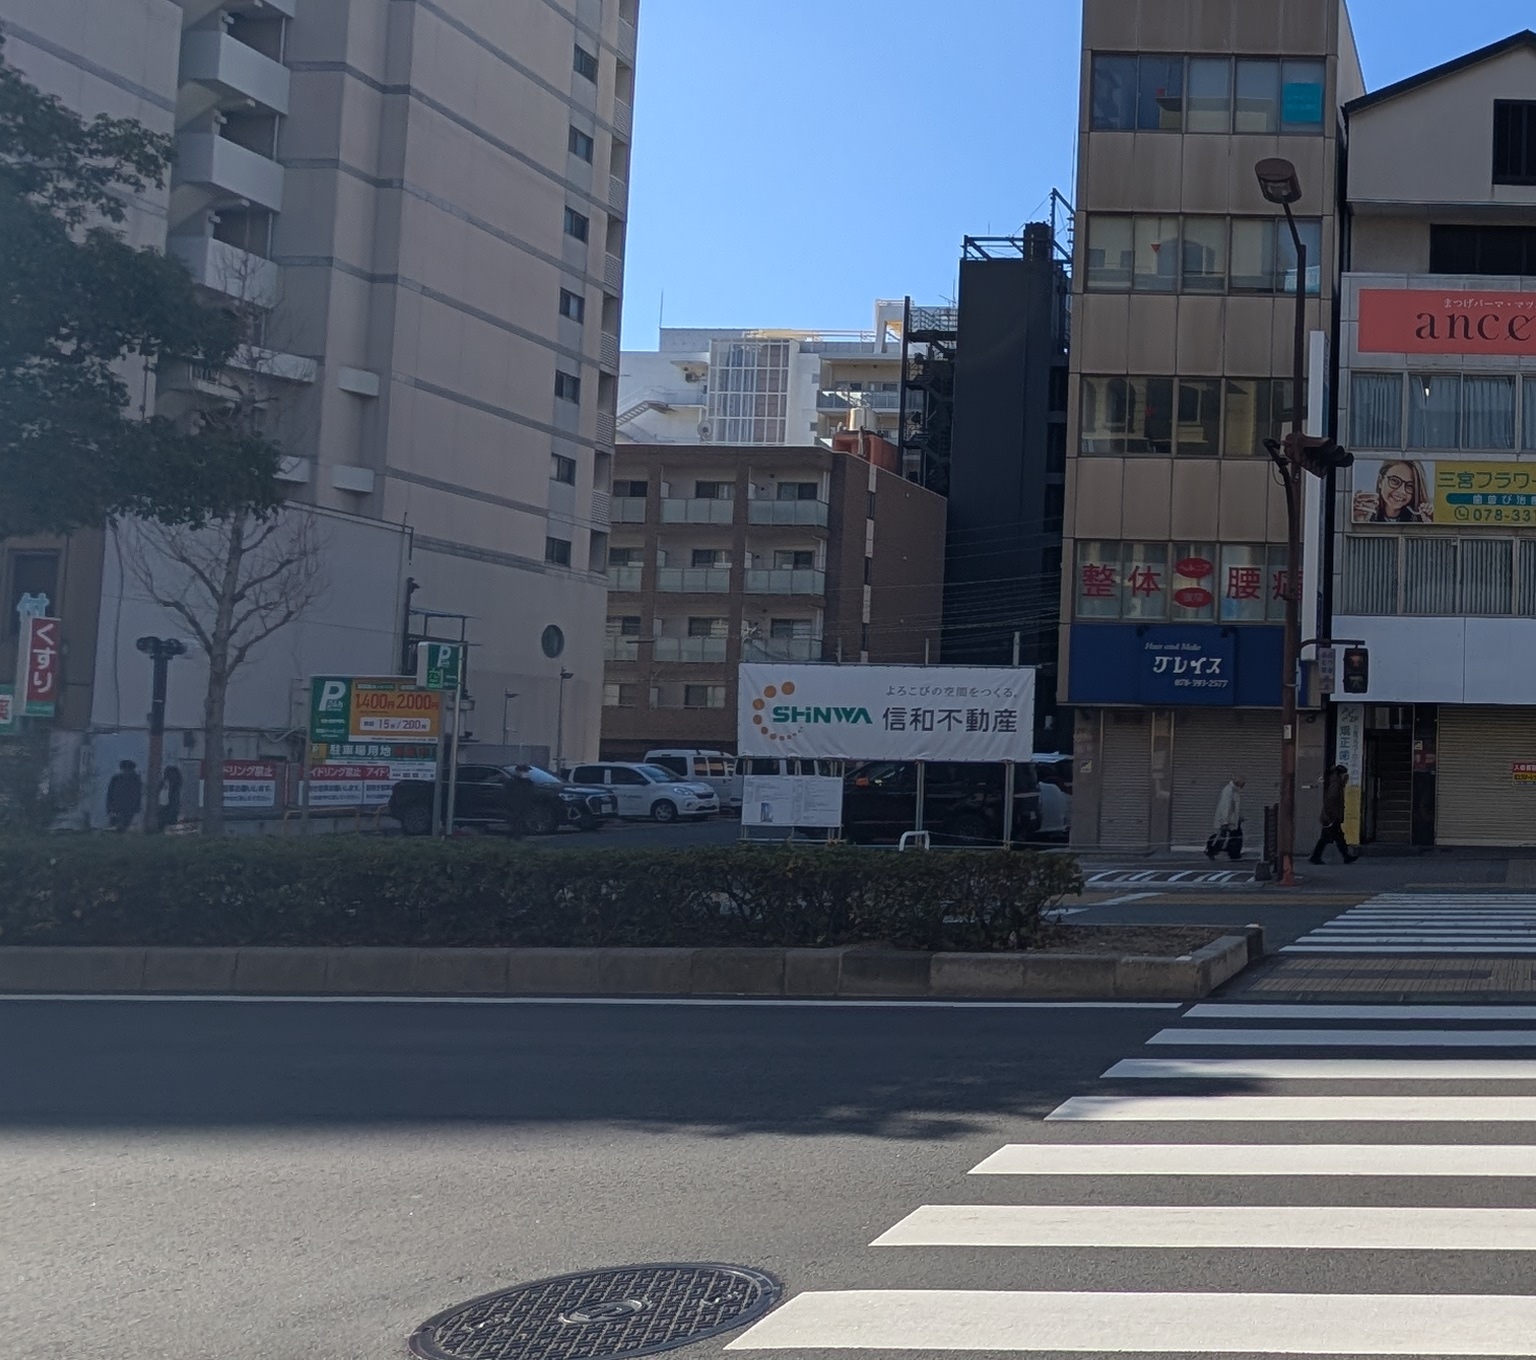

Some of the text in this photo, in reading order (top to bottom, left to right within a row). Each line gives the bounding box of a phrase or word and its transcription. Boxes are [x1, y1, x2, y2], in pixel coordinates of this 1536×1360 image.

[1416, 312, 1536, 341] ance
[1082, 564, 1161, 599] 整体
[32, 623, 57, 694] くすり
[437, 644, 451, 667] P
[318, 680, 346, 711] P
[886, 685, 1018, 698] よろこびの空間をつくる。
[882, 706, 1018, 733] 信和不動産
